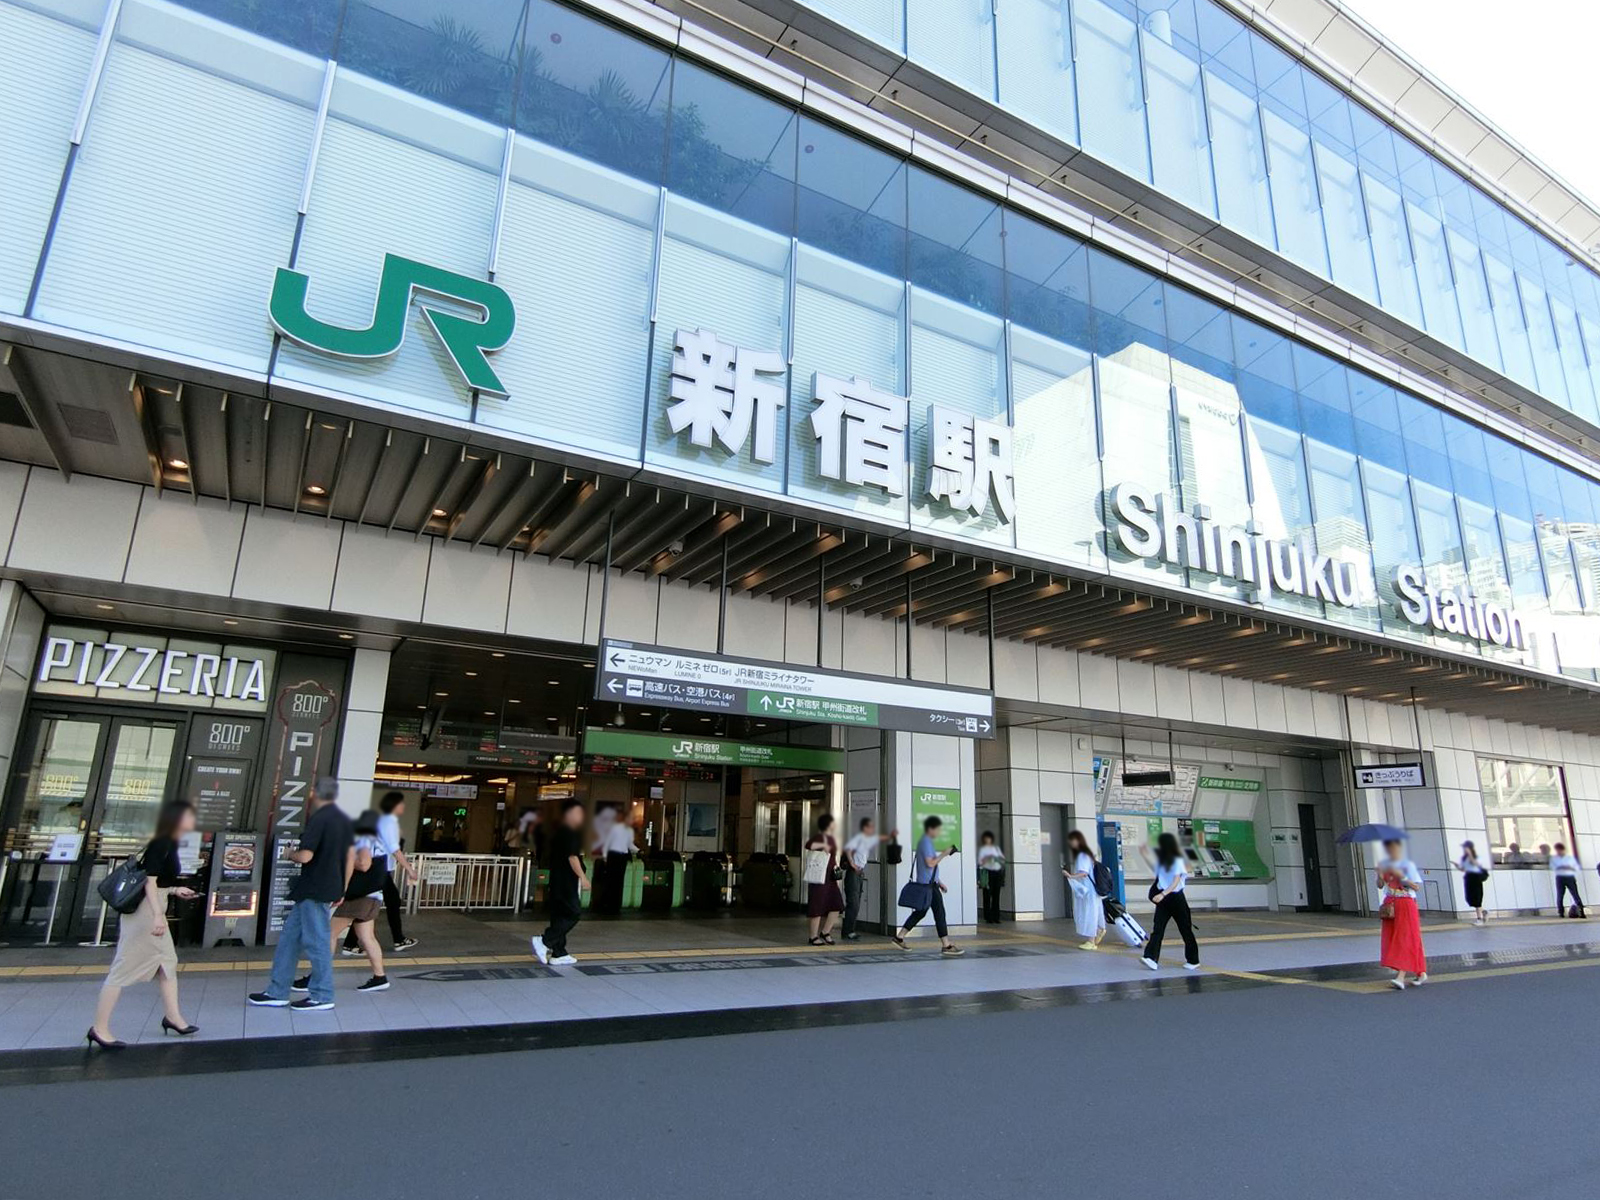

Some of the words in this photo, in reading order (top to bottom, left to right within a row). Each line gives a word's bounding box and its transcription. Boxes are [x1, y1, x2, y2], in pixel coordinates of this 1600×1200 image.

[268, 252, 516, 400] JR
[666, 327, 1016, 526] 新宿駅
[1110, 481, 1362, 609] Shinjuku
[1392, 564, 1530, 653] Station
[39, 637, 266, 702] PIZZERIA
[629, 654, 672, 667] ニュウマン
[675, 660, 700, 671] ルミネ
[776, 696, 795, 711] JR
[796, 698, 820, 710] 新宿駅
[209, 723, 251, 745] 800°
[672, 741, 693, 754] JR
[694, 742, 720, 754] 新宿駅
[276, 731, 314, 835] PIZZ
[920, 793, 932, 801] JR
[453, 807, 467, 816] JR
